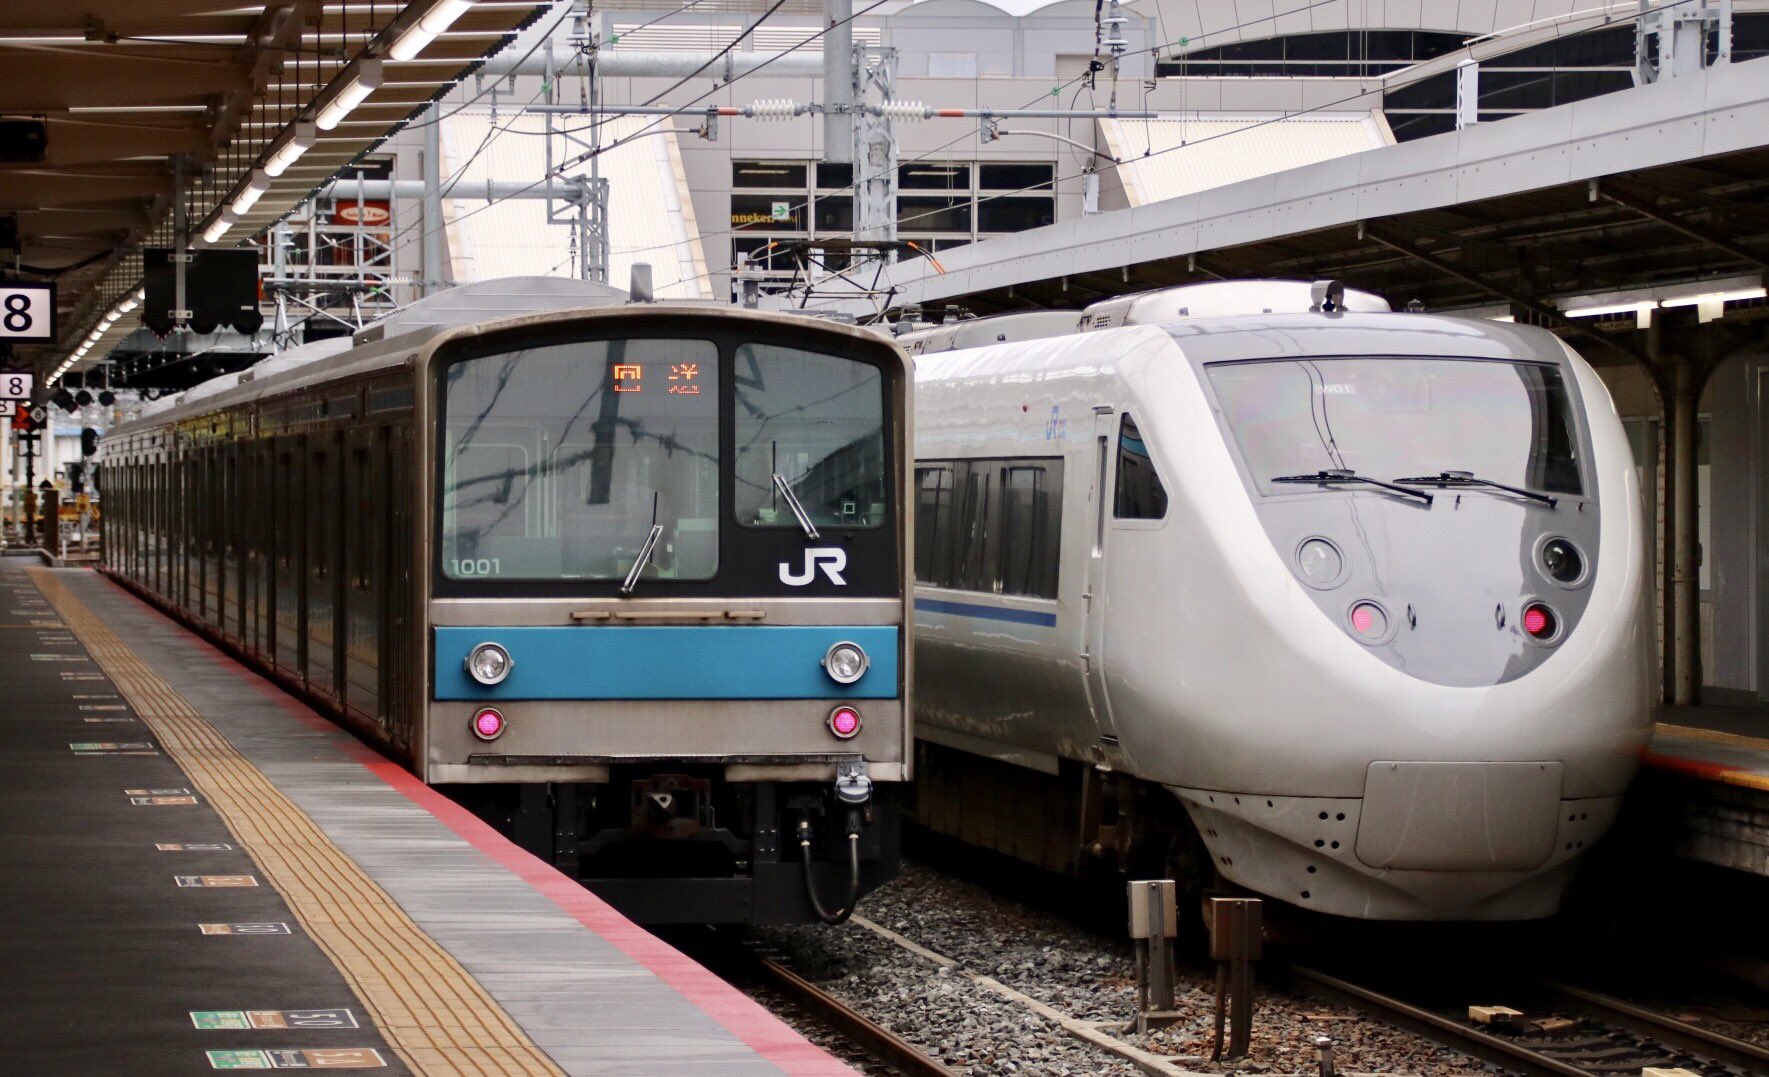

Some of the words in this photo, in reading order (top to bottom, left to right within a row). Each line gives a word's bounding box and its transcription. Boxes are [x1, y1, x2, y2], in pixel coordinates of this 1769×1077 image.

[4, 294, 33, 332] 8
[9, 377, 23, 396] 8
[452, 558, 500, 575] 1001
[779, 547, 847, 586] JR
